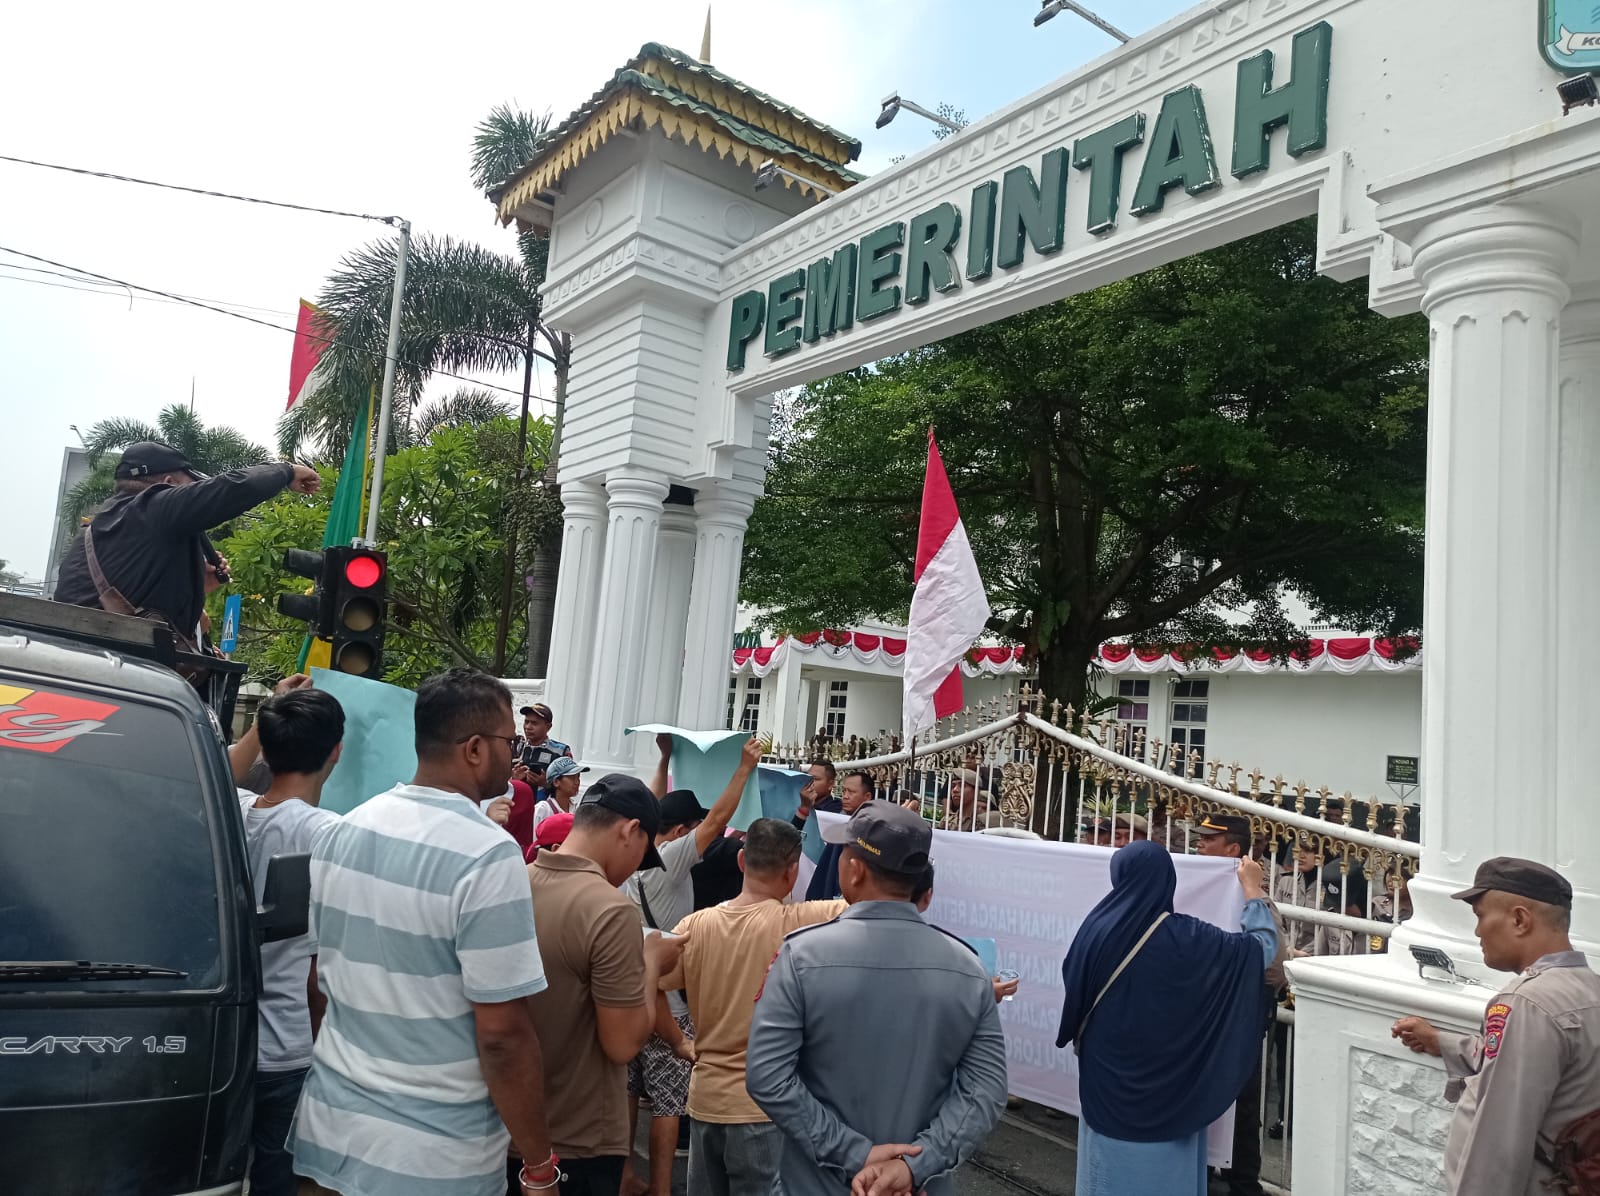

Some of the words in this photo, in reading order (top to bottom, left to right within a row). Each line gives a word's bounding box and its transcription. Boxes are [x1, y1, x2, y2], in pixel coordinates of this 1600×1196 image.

[726, 20, 1333, 372] PEMERINTAH
[0, 1036, 133, 1054] CARRY
[142, 1035, 186, 1053] 1.5
